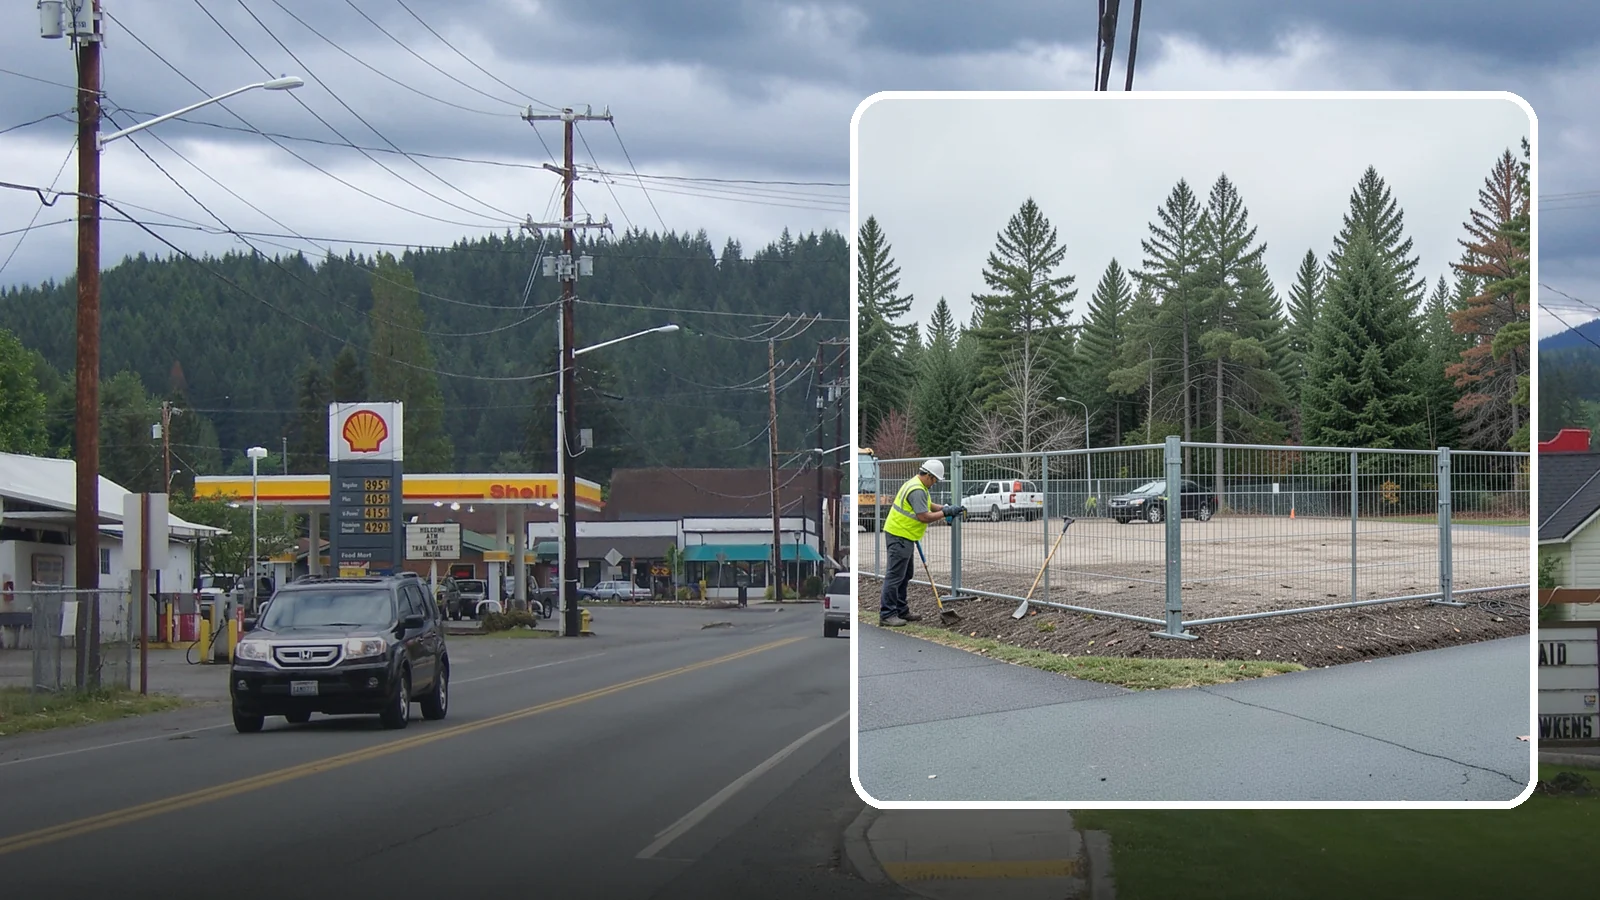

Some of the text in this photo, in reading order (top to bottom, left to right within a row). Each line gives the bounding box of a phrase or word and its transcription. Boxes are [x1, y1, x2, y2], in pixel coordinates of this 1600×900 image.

[365, 480, 384, 490] 395
[490, 484, 547, 499] Shell
[365, 494, 384, 504] 405
[365, 508, 384, 518] 415
[365, 522, 384, 532] 429
[1538, 642, 1567, 665] AID
